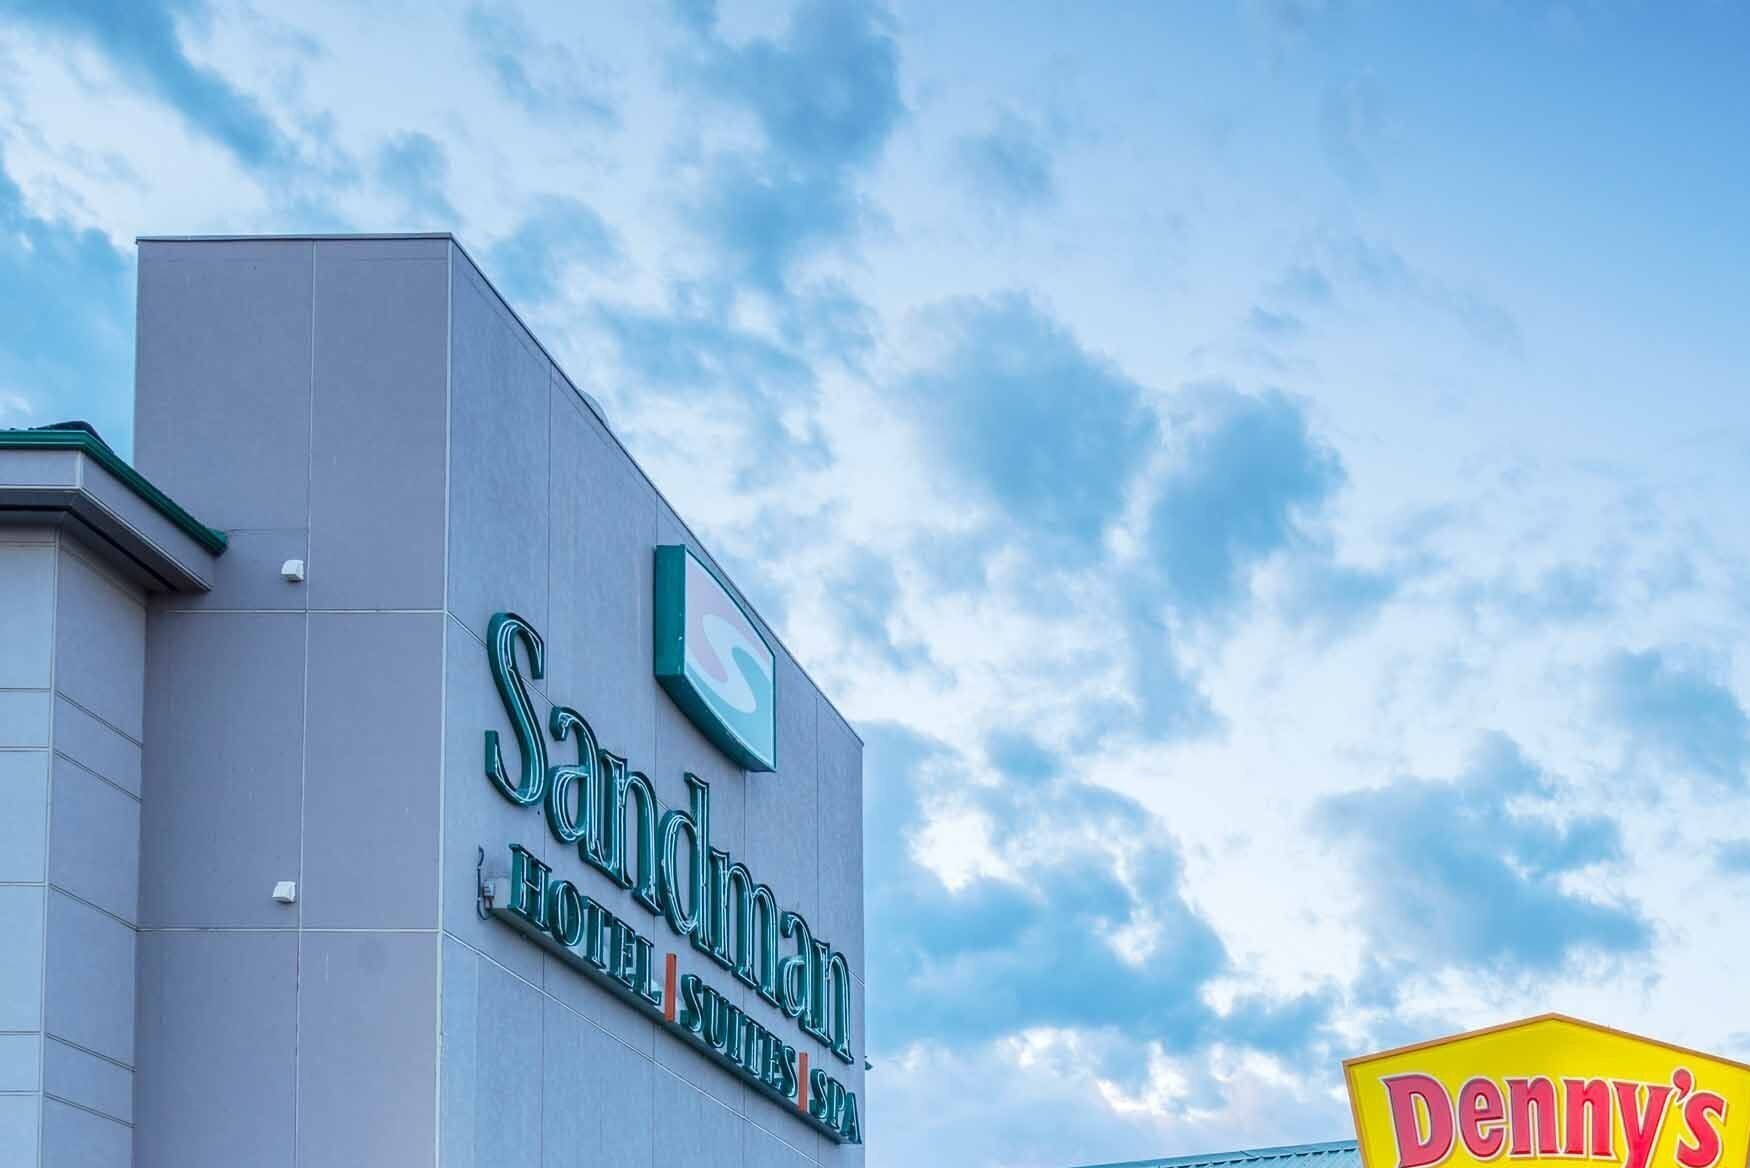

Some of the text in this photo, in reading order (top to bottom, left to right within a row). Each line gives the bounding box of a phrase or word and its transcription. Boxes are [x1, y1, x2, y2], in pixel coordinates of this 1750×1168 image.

[485, 612, 854, 1065] Sandman
[509, 843, 862, 1145] HOTEL SUITES SPA
